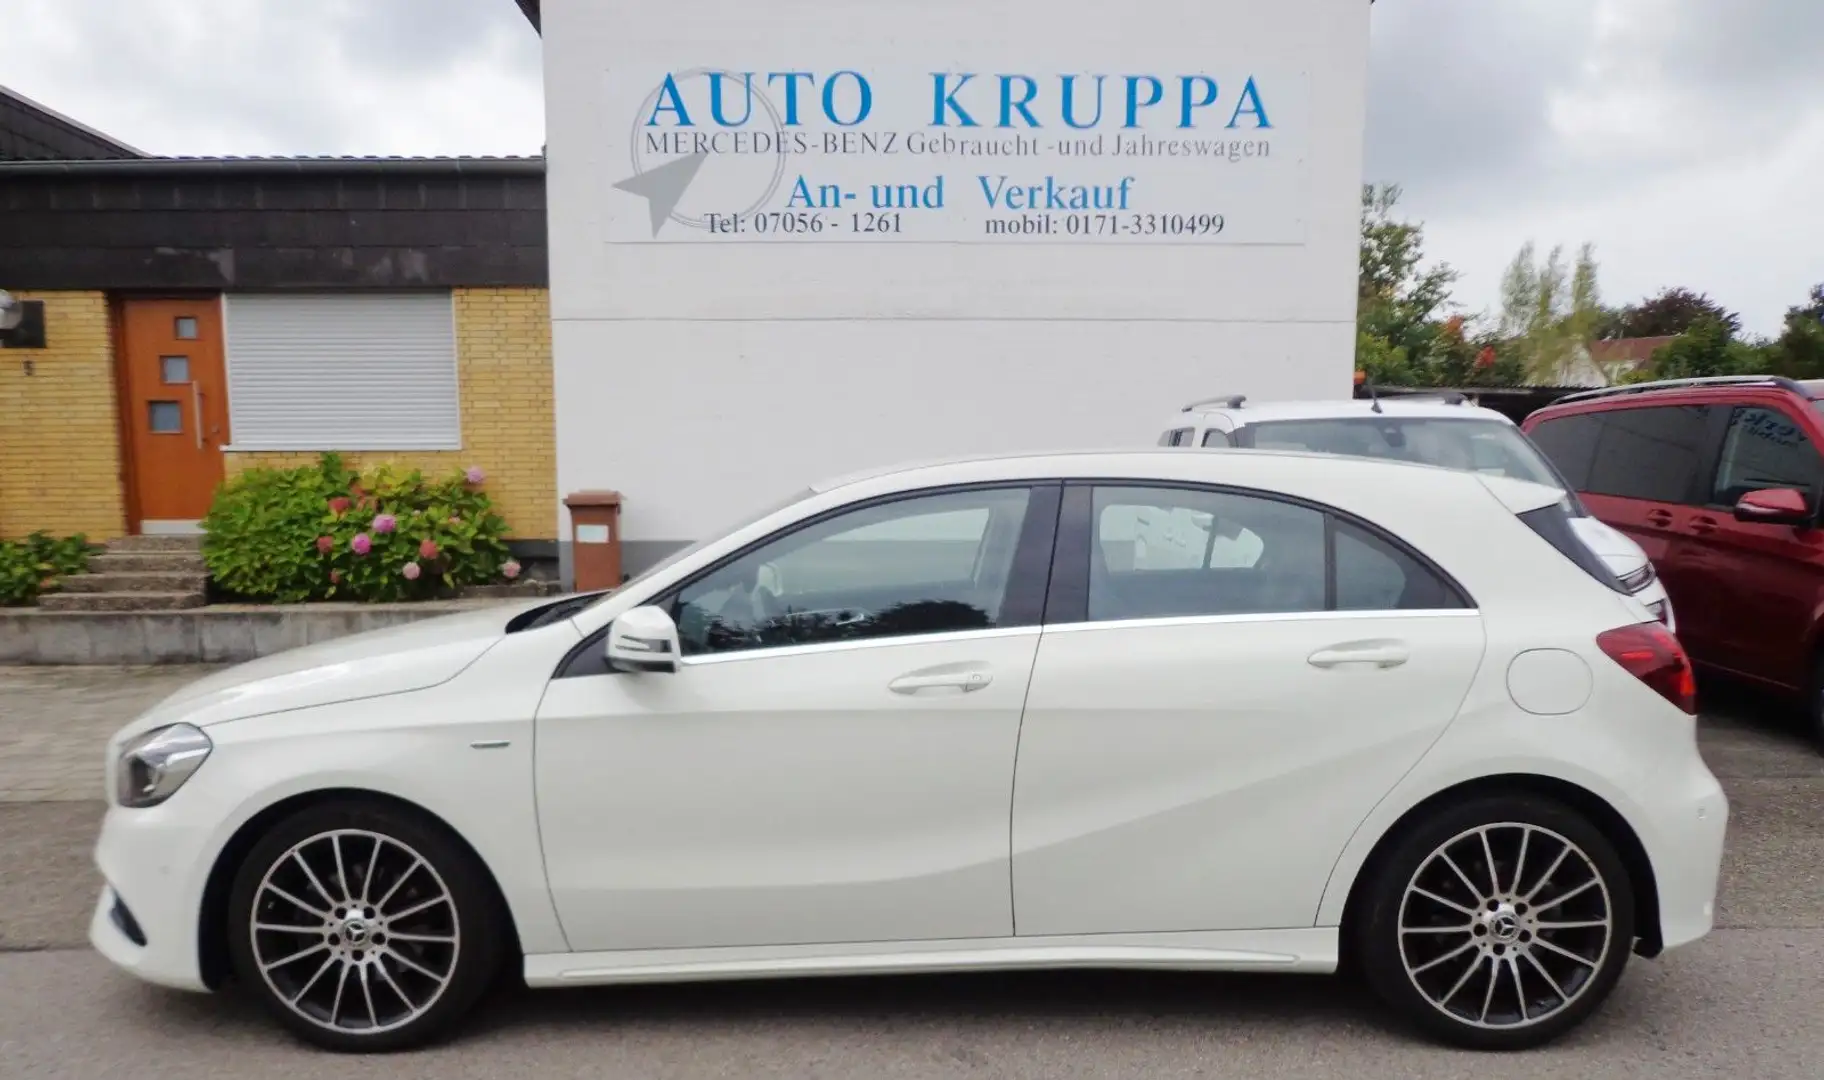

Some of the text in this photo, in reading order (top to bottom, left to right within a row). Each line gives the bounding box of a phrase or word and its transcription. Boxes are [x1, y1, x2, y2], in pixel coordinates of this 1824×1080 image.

[644, 70, 1274, 129] AUTO KRUPPA
[646, 131, 899, 155] MERCEDES-BENZ
[906, 132, 1039, 156] Gebraucht
[1111, 134, 1271, 163] Jahreswagen
[785, 174, 1136, 211] An- und Verkauf
[704, 212, 746, 234] Tel:
[754, 212, 824, 234] 07056
[851, 212, 902, 233] 1261
[985, 213, 1226, 236] mobil: 0171-3310499
